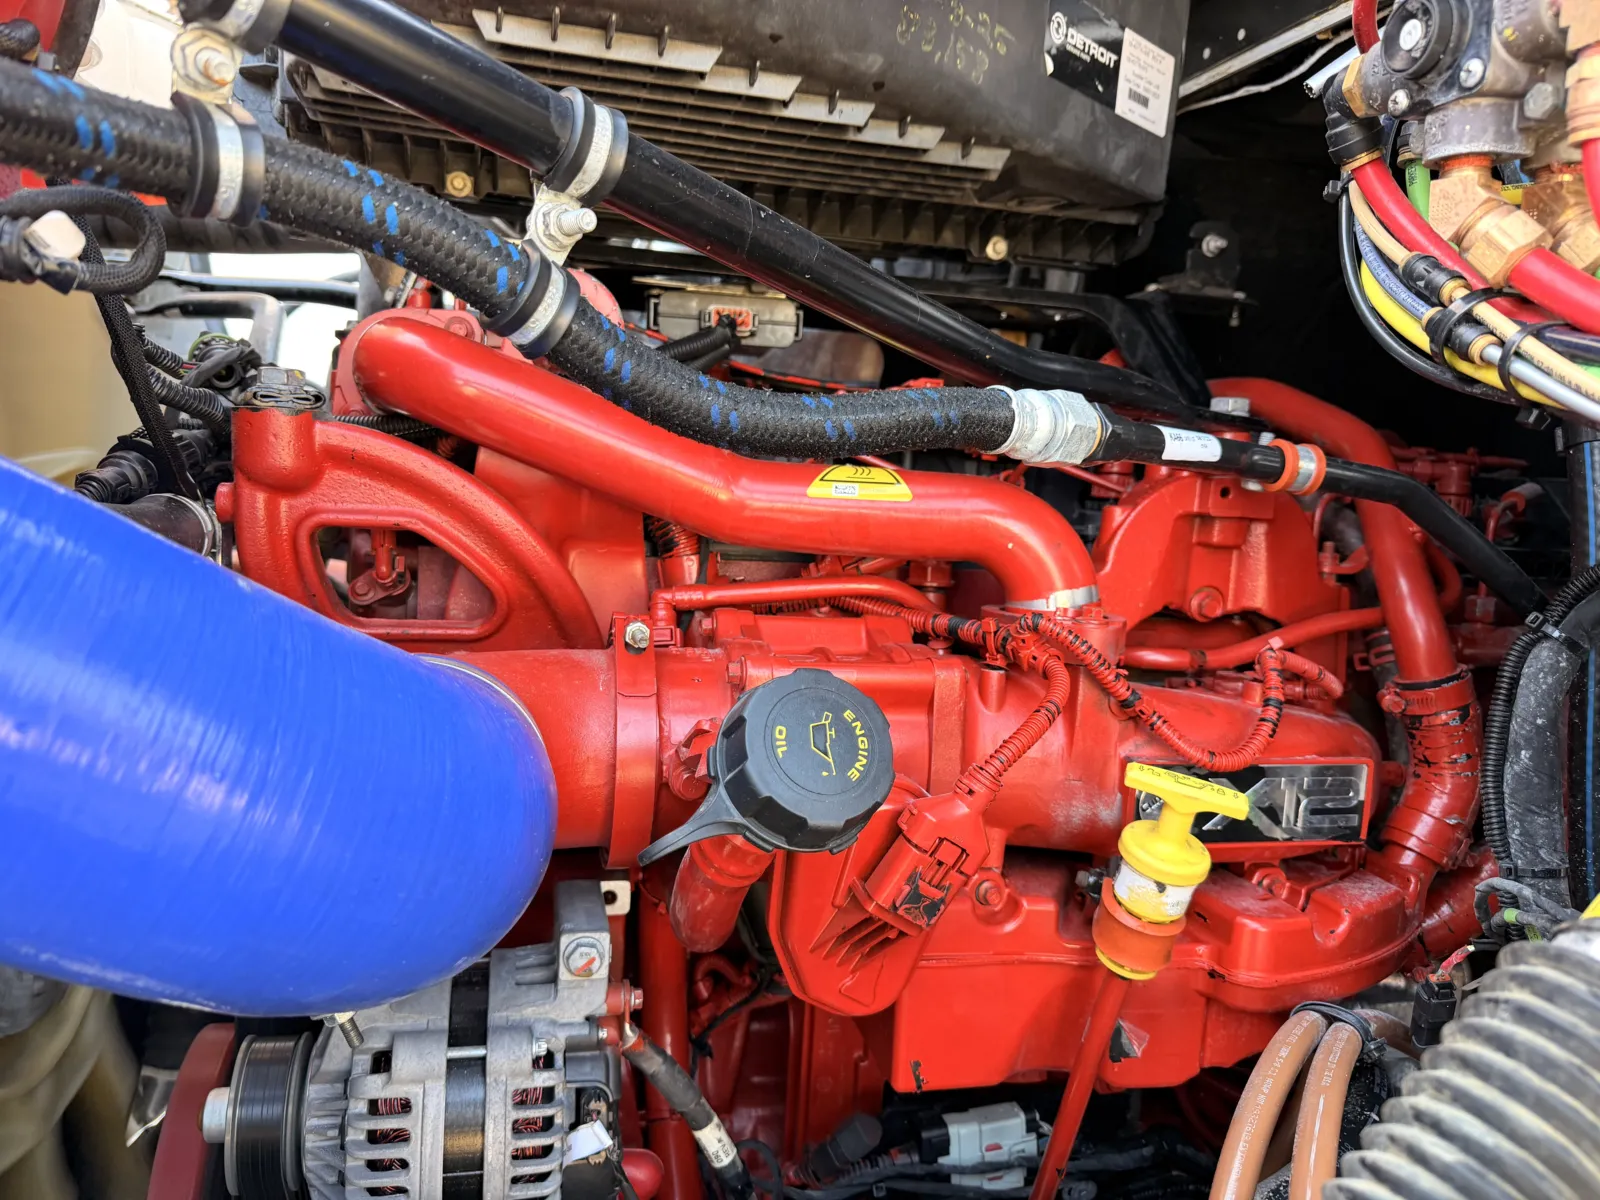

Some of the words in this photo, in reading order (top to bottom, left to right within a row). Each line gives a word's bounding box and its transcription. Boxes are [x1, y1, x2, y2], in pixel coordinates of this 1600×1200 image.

[1066, 26, 1119, 69] DETROIT
[775, 725, 788, 759] OIL
[843, 709, 869, 782] ENGINE
